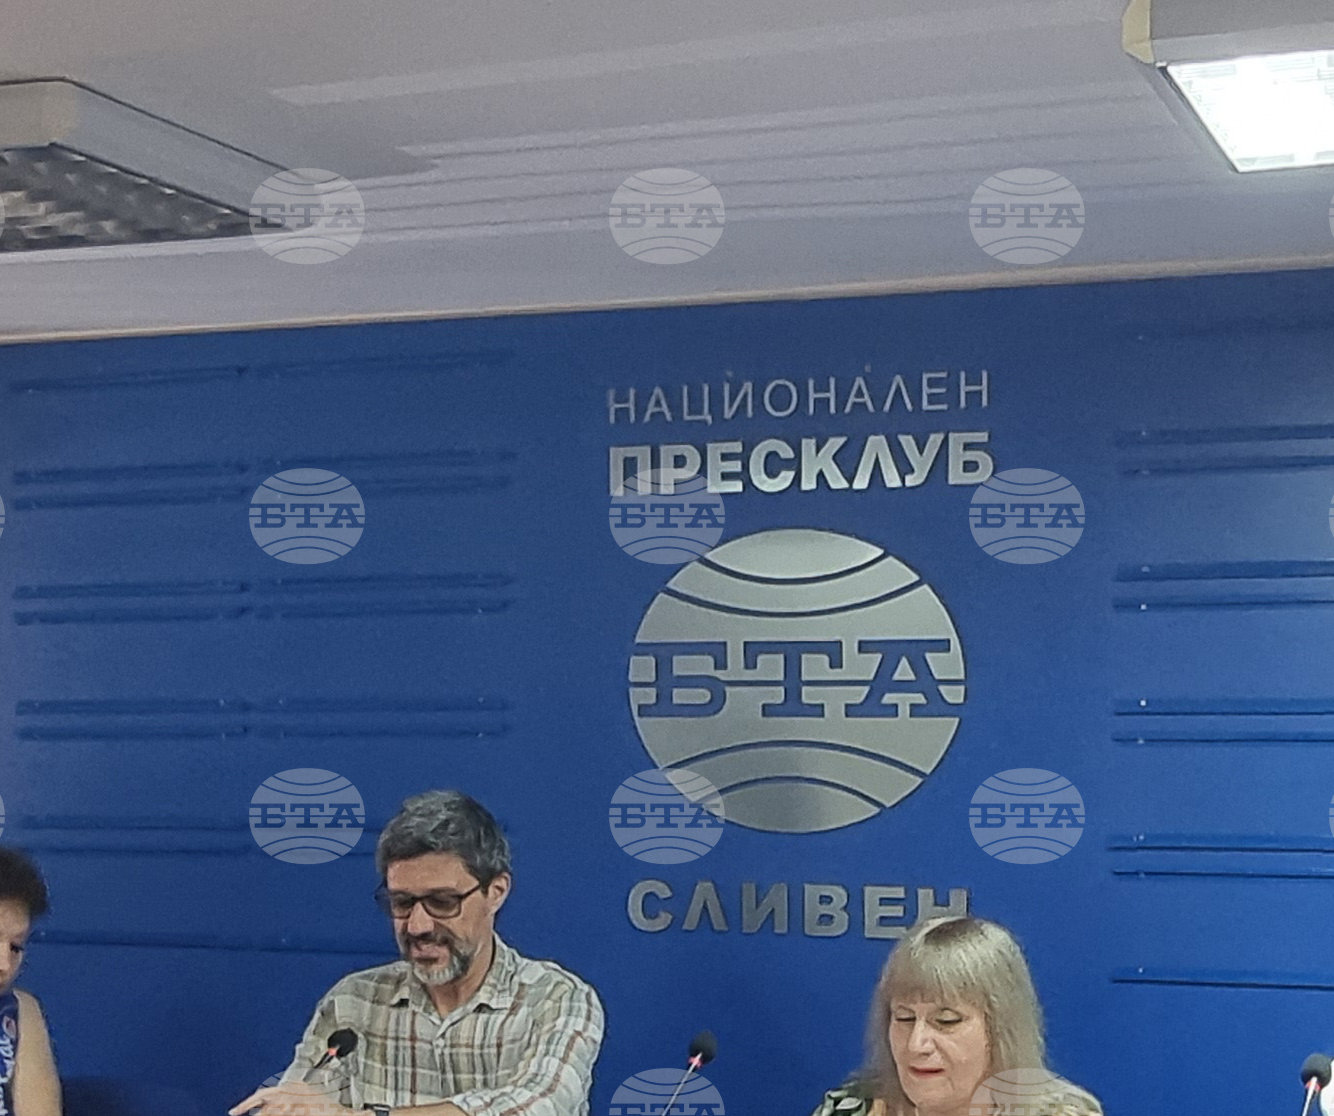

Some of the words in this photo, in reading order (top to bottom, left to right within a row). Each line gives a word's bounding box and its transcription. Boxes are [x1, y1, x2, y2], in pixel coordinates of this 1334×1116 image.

[608, 369, 988, 425] НАЦИОНАЛЕН
[608, 431, 994, 496] ПРЕСКЛУБ
[633, 639, 965, 719] БТА
[627, 879, 967, 939] СЛИВЕН
